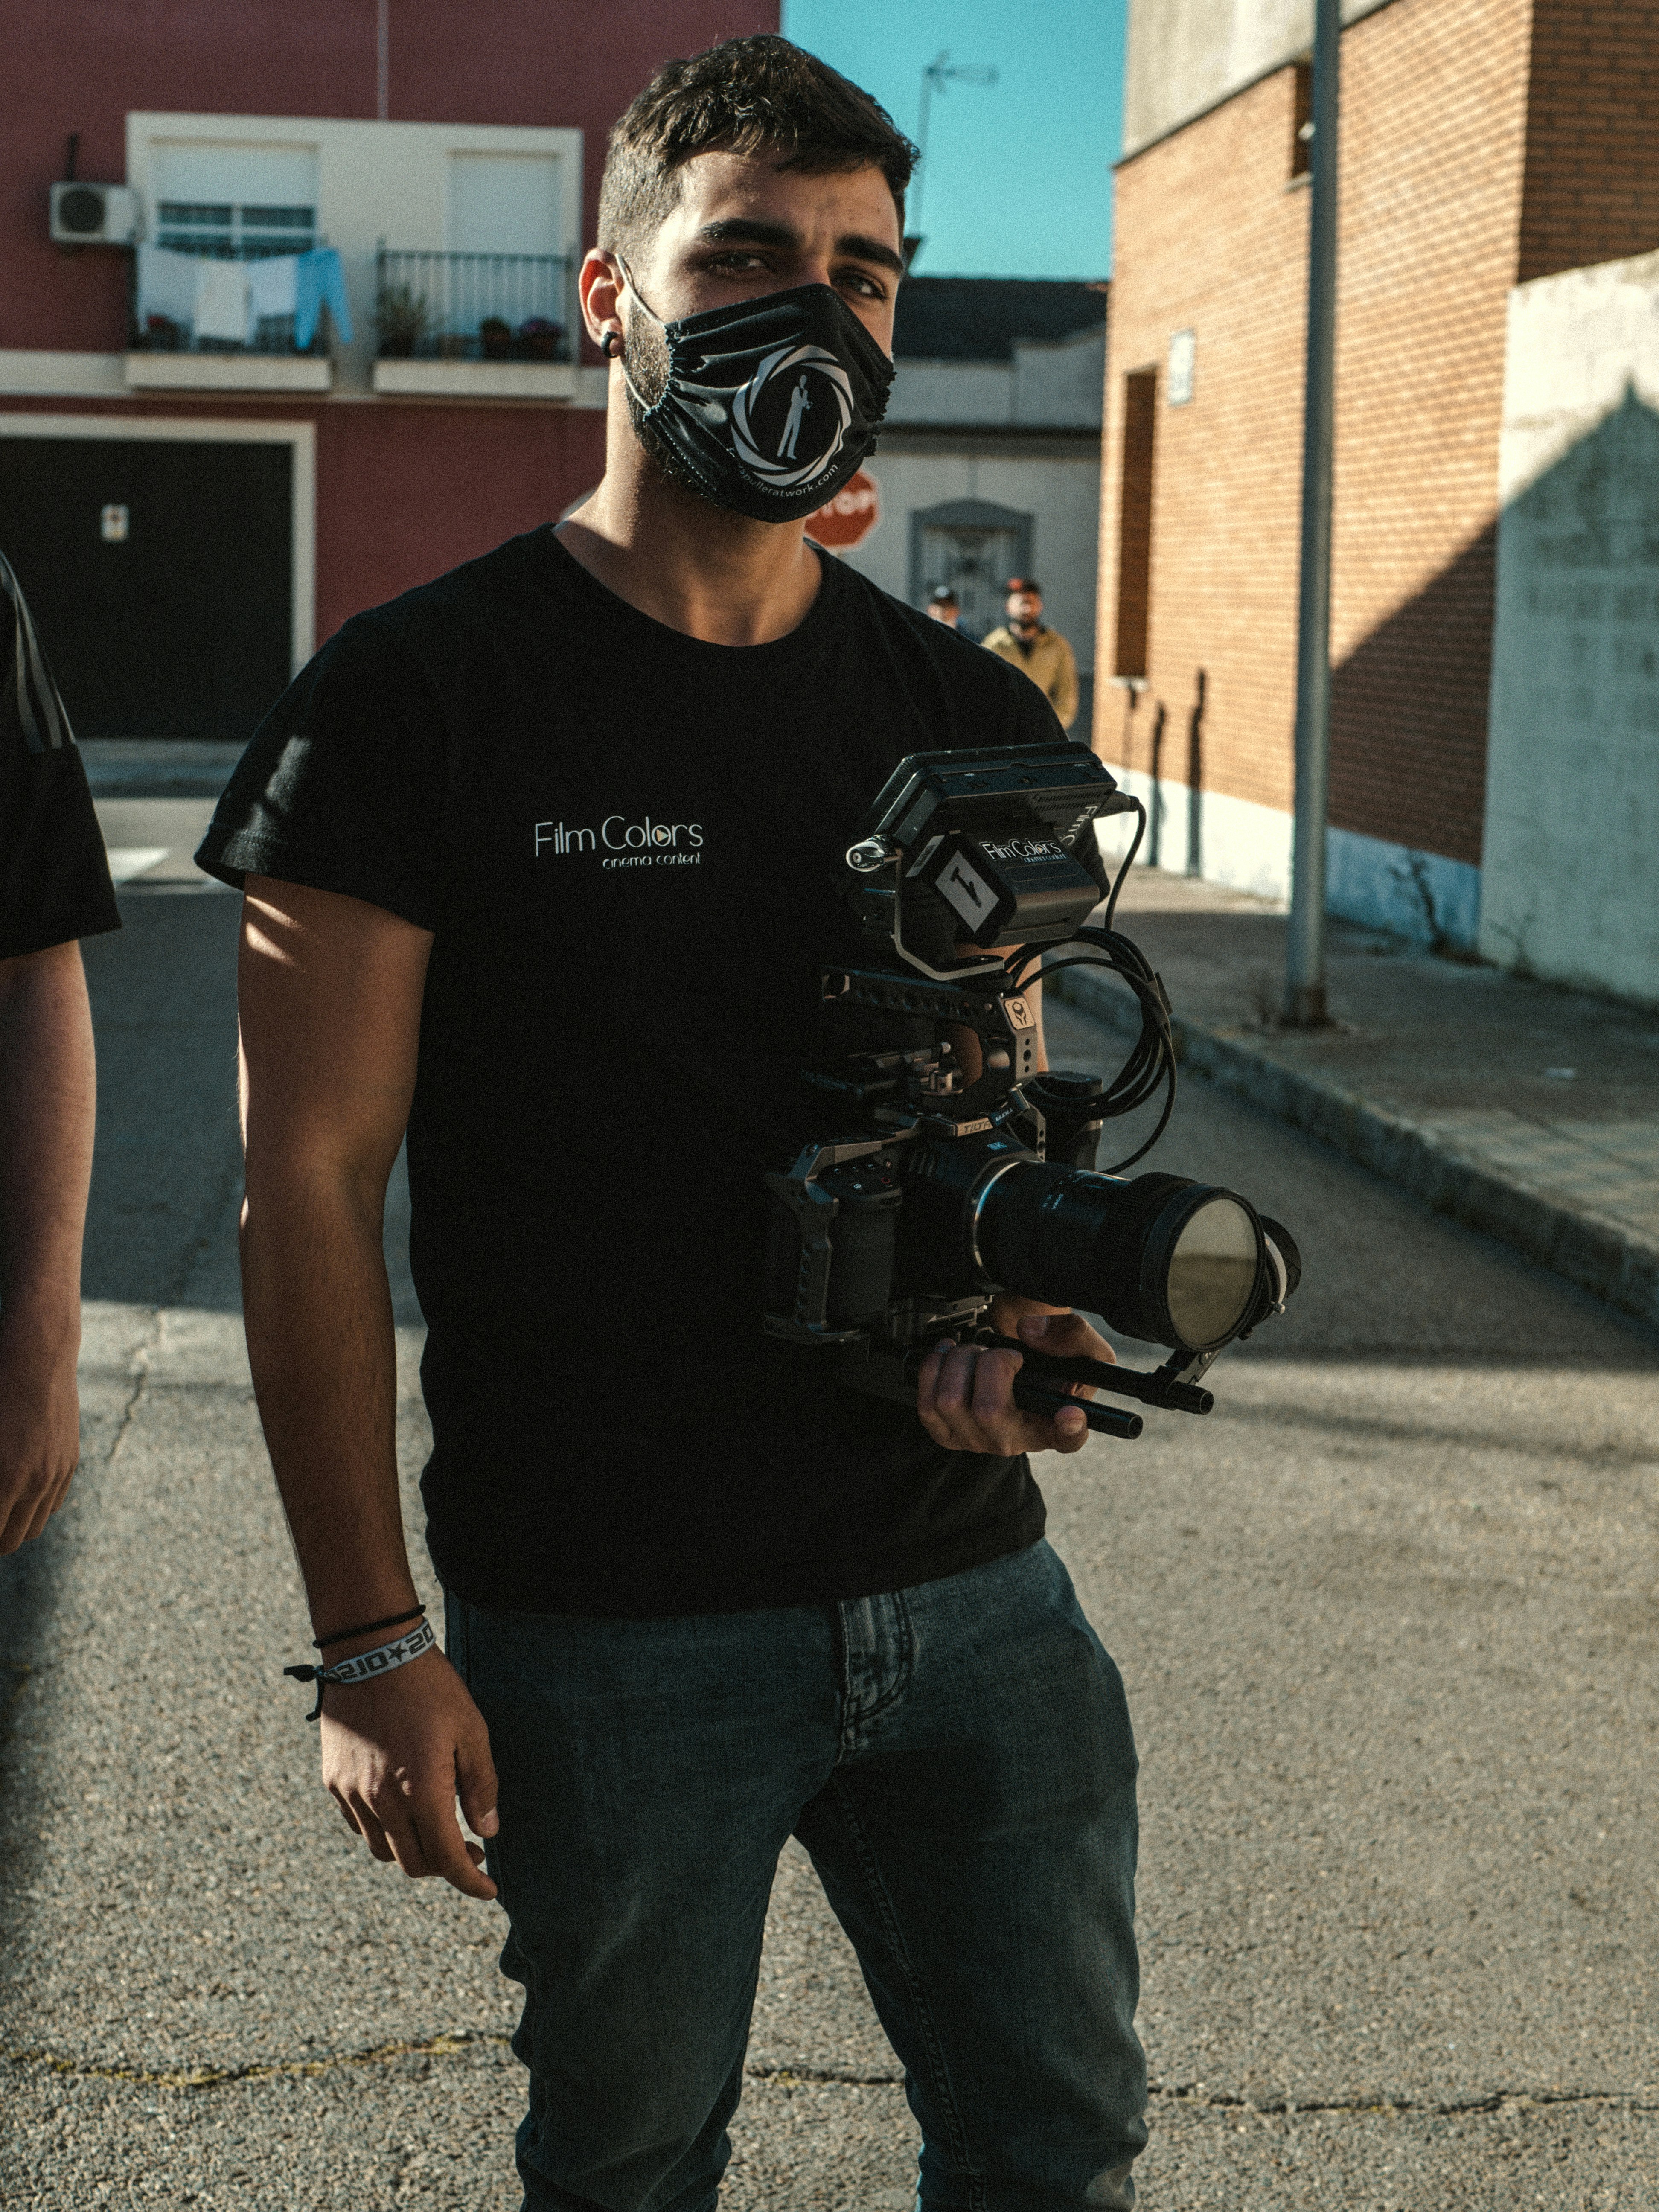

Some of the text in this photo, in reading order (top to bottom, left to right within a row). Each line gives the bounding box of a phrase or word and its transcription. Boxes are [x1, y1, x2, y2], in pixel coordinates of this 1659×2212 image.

[1068, 806, 1098, 832] Film
[535, 815, 703, 857] Film Colors
[602, 852, 700, 869] cinema content
[982, 840, 1061, 859] Film Colors
